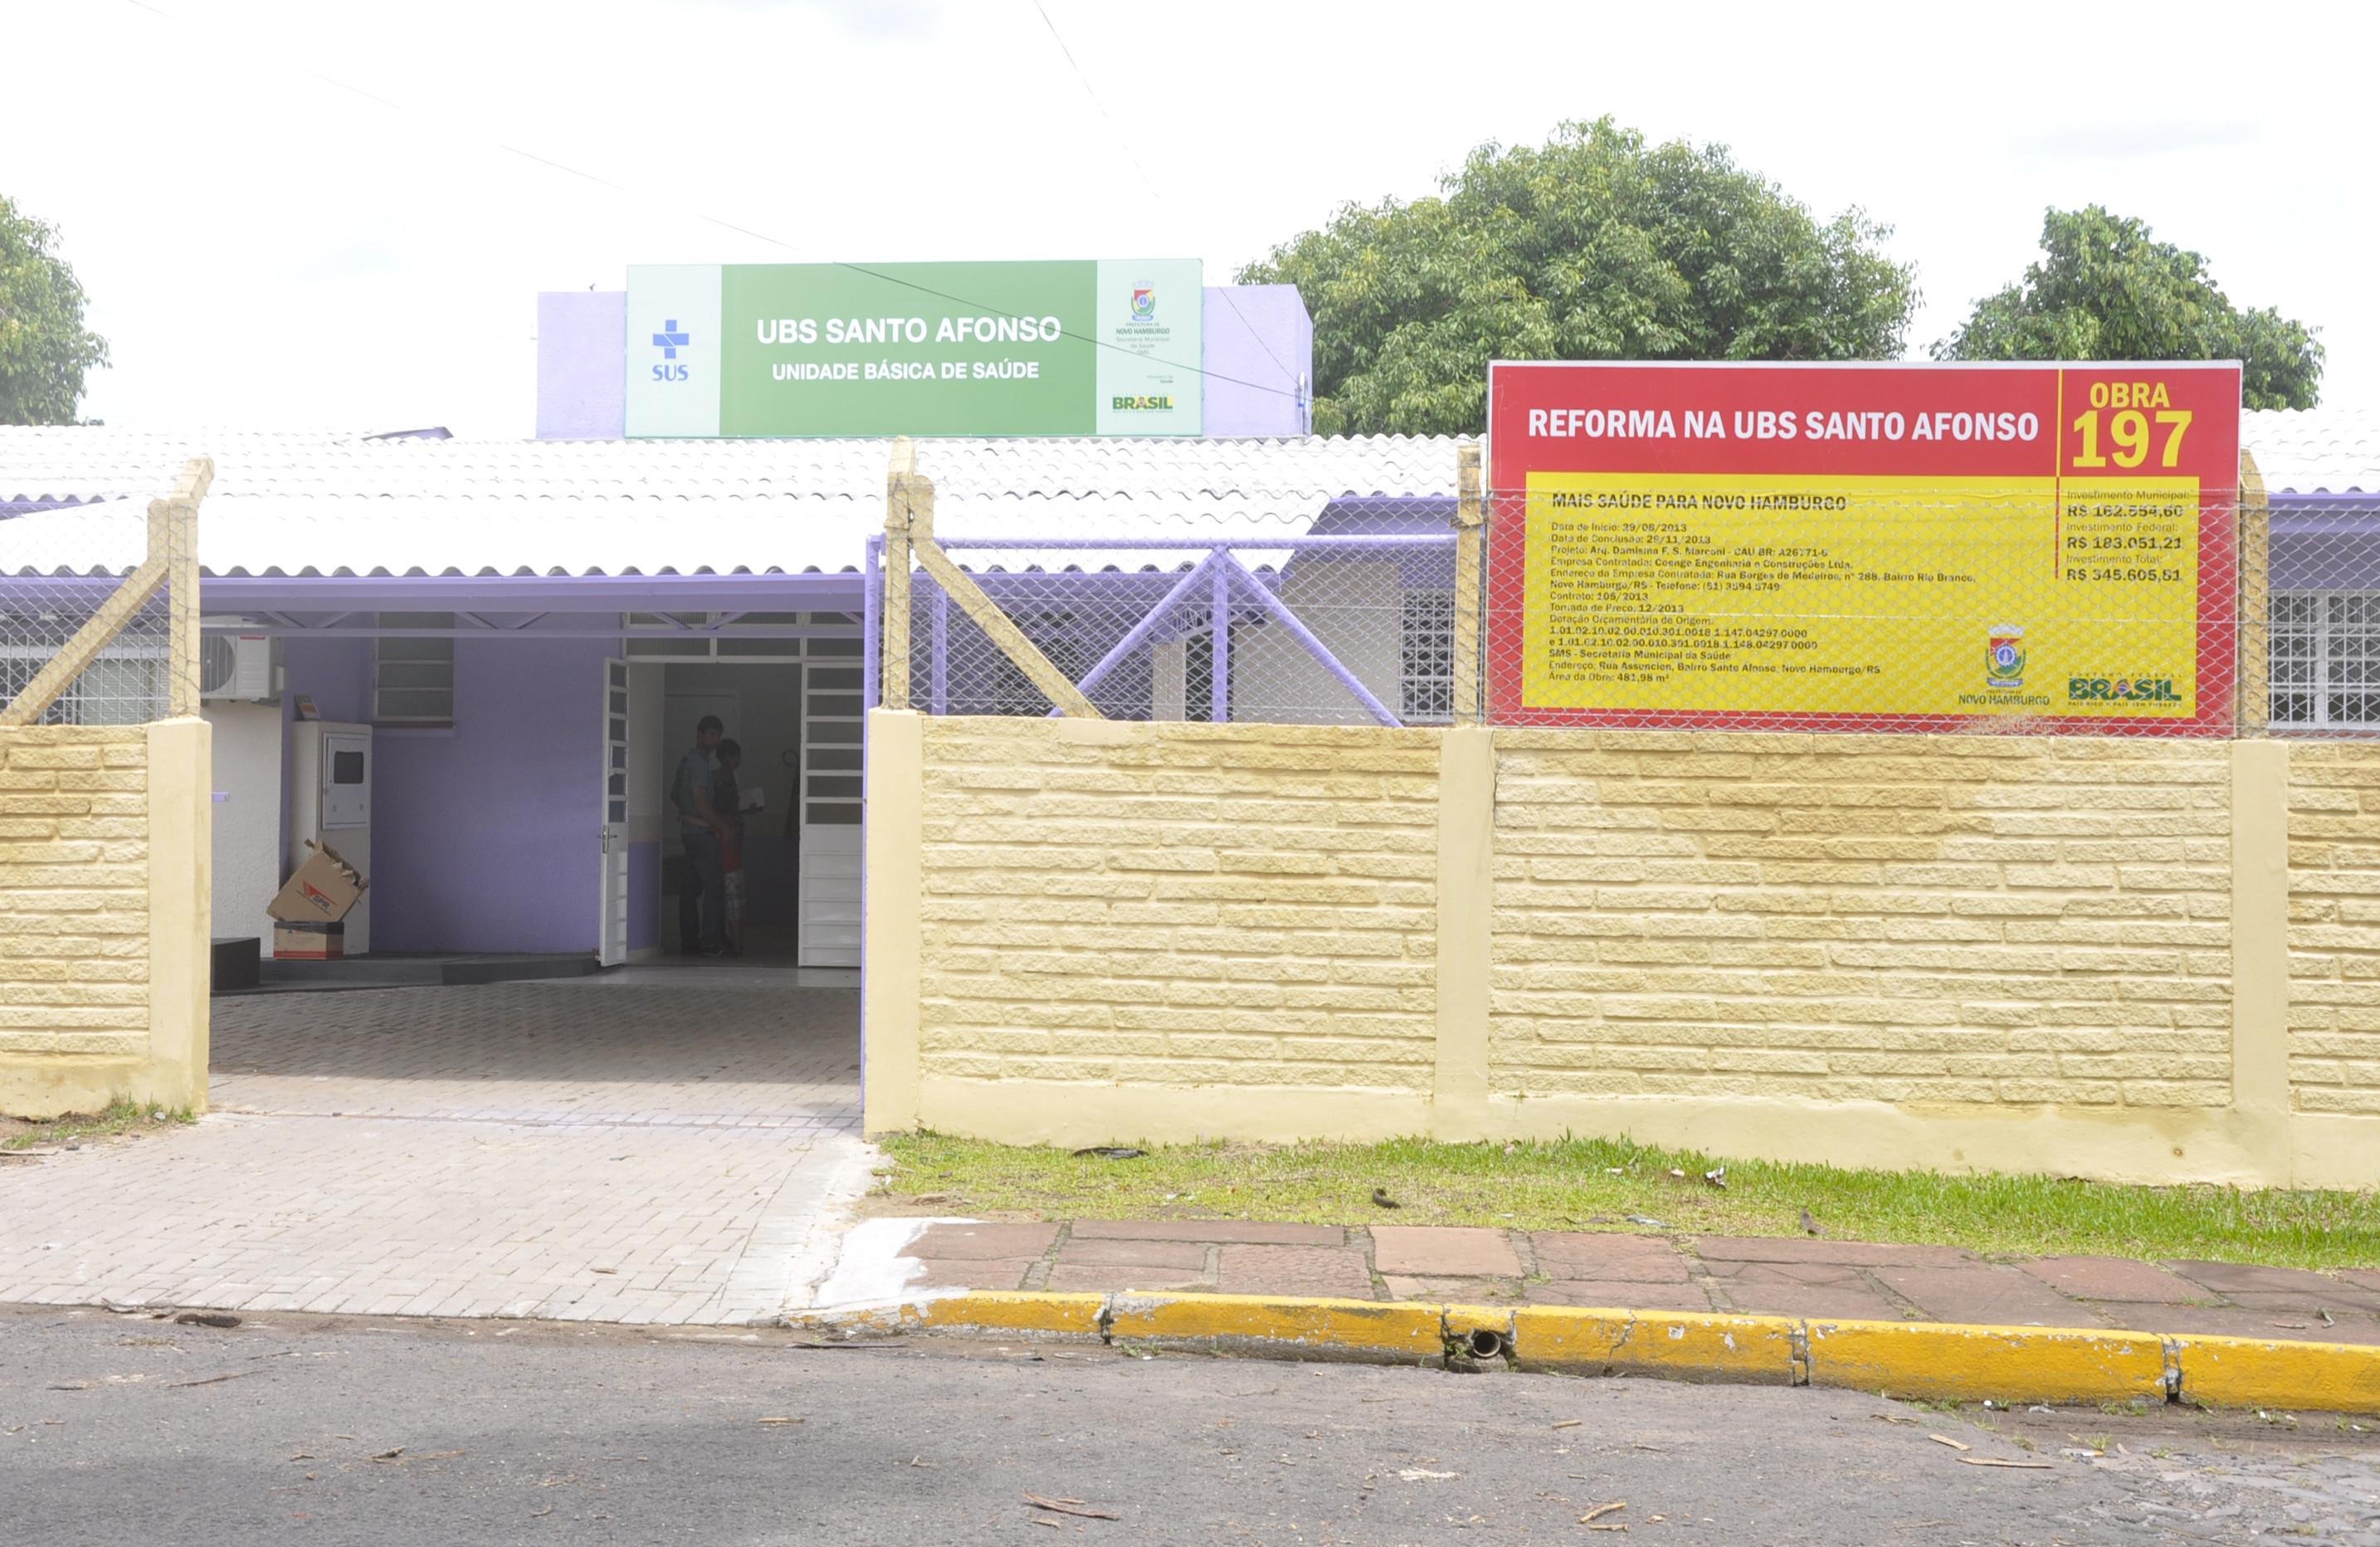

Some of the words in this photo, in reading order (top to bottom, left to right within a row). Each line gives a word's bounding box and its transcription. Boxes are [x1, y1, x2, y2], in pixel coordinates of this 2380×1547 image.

[757, 318, 817, 344] UBS
[826, 317, 926, 344] SANTO
[935, 315, 1061, 343] AFONSO
[652, 364, 689, 382] SUS
[772, 363, 859, 381] UNIDADE
[864, 359, 935, 380] BÁSICA
[940, 362, 967, 379] DE
[973, 356, 1039, 379] SAÚDE
[2090, 381, 2170, 409] OBRA
[1113, 397, 1173, 410] BRASIL
[1529, 408, 1675, 438] REFORMA
[1685, 410, 1726, 439] NA
[1734, 410, 1797, 440] UBS
[1805, 411, 1905, 441] SANTO
[1911, 412, 2039, 442] AFONSO
[2072, 410, 2193, 469] 197
[1553, 493, 1593, 509] MAIS
[1597, 490, 1651, 510] SAÚDE
[1656, 494, 1700, 510] PARA
[1702, 495, 1745, 510] NOVO
[1751, 495, 1847, 511] HAMBURGO
[2067, 490, 2133, 500] Investimento
[2067, 505, 2088, 518] R$
[2093, 505, 2184, 520] 162.554,60
[1551, 522, 1574, 531] Data
[1577, 522, 1589, 531] de
[2066, 523, 2133, 531] Investimento
[2137, 523, 2178, 532] Federal:
[1551, 534, 1574, 543] Data
[1577, 534, 1588, 543] de
[2067, 536, 2088, 549] R$
[2093, 536, 2182, 551] 183.051,21
[1551, 545, 1587, 556] Projeto:
[1673, 547, 1682, 556] S.
[1734, 548, 1756, 557] CAU
[1550, 558, 1593, 568] Empresa
[1695, 559, 1752, 570] Engenharia
[2066, 554, 2132, 564] Investimento
[1550, 569, 1595, 580] Endereço
[1597, 569, 1610, 578] da
[1612, 570, 1656, 581] Empresa
[1717, 571, 1737, 579] Rua
[1739, 571, 1774, 582] Borges
[1884, 573, 1915, 582] Bairro
[1918, 573, 1934, 582] Rio
[2067, 569, 2087, 581] R$
[1550, 580, 1575, 589] Novo
[1550, 603, 1588, 612] Tomada
[1591, 603, 1603, 612] de
[1549, 614, 1590, 625] Dotação
[1661, 616, 1674, 625] de
[1549, 649, 1572, 658] SMS
[1580, 650, 1631, 659] Secretaria
[1634, 650, 1683, 661] Municipal
[1599, 661, 1619, 671] Rua
[1677, 662, 1708, 671] Bairro
[1710, 663, 1739, 672] Santo
[1782, 664, 1807, 673] Novo
[1548, 671, 1572, 681] Área
[1573, 673, 1586, 681] da
[2069, 678, 2182, 701] BRASIL
[1958, 694, 1987, 705] NOVO
[1988, 695, 2051, 706] HAMBURGO
[313, 895, 330, 910] SPR
